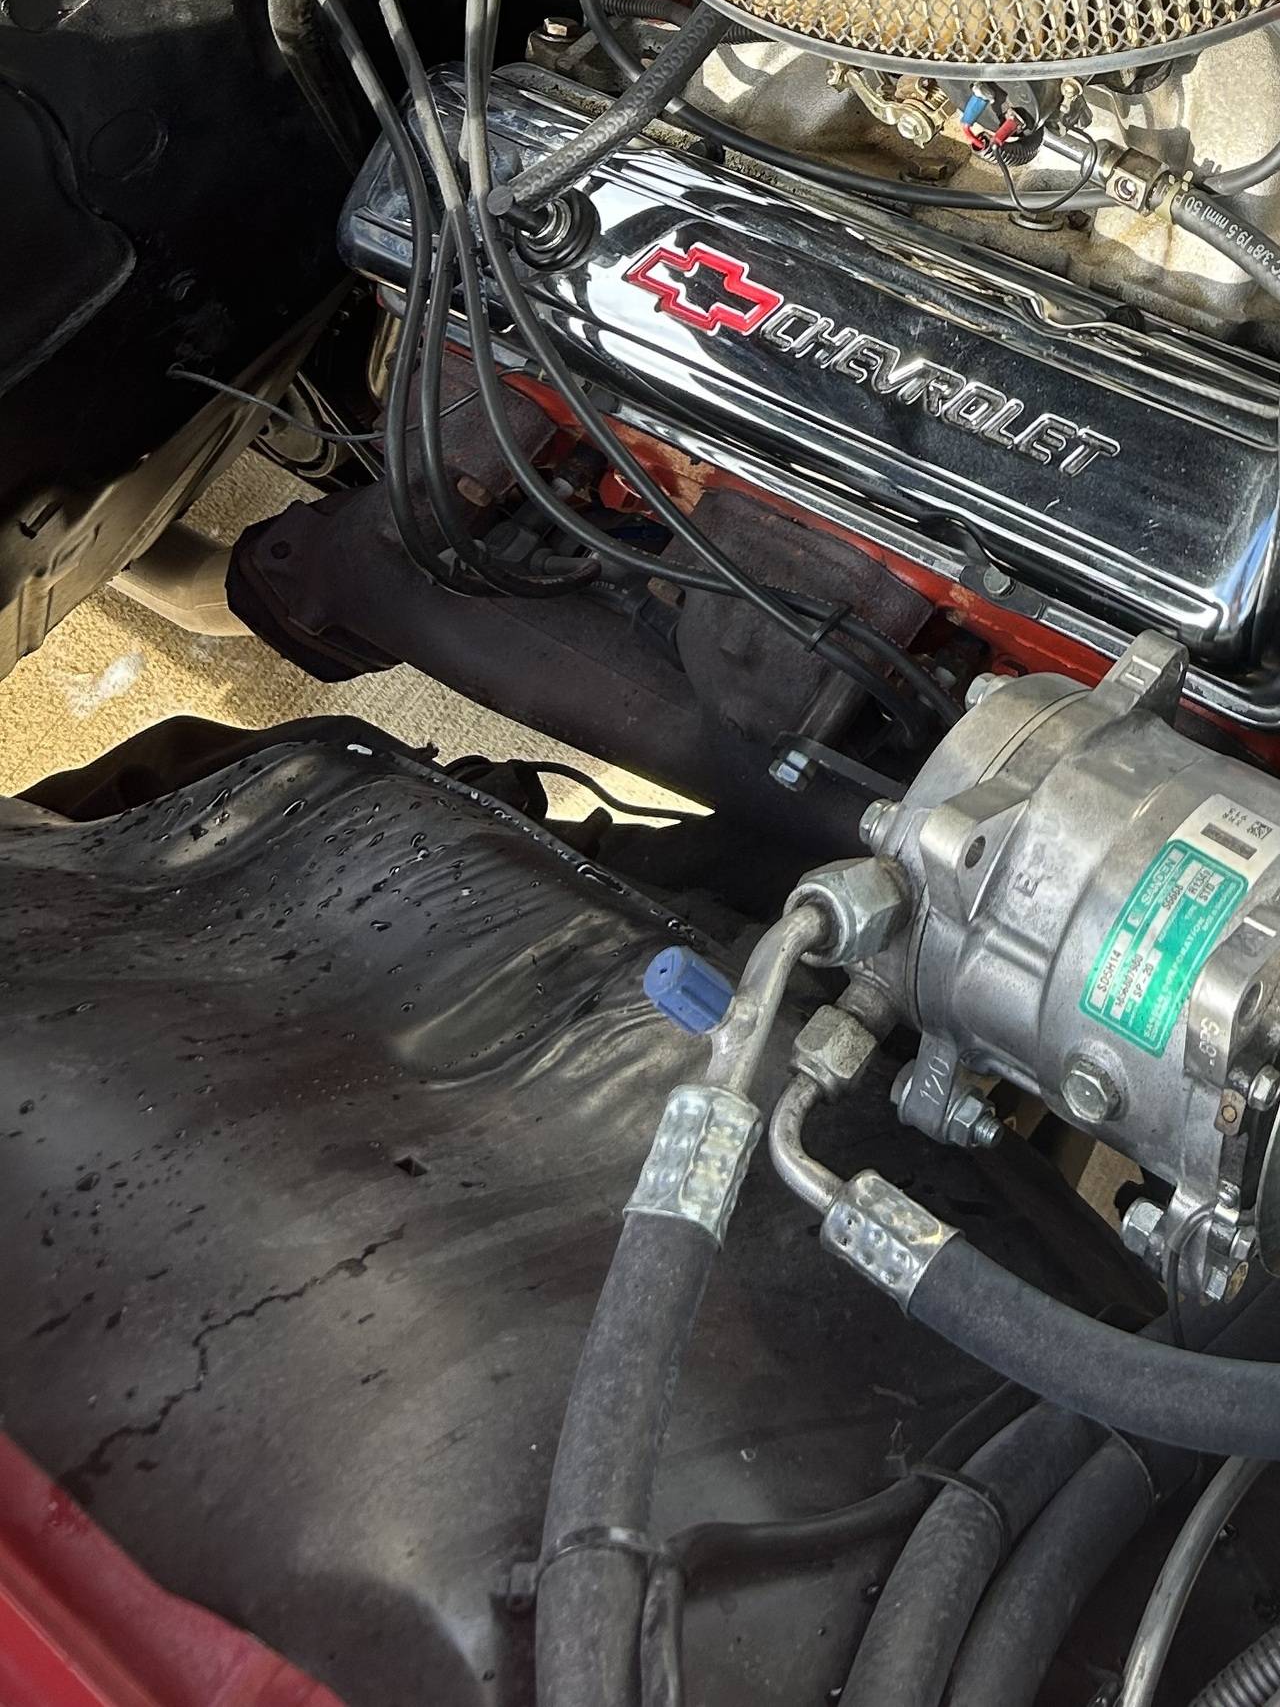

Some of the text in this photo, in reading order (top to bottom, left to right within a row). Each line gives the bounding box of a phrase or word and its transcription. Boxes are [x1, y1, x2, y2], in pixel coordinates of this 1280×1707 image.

[1182, 194, 1203, 215] 50
[762, 304, 1120, 478] CHEVROLET
[1142, 858, 1176, 904] SANDEN
[1096, 951, 1121, 992] SD5H14
